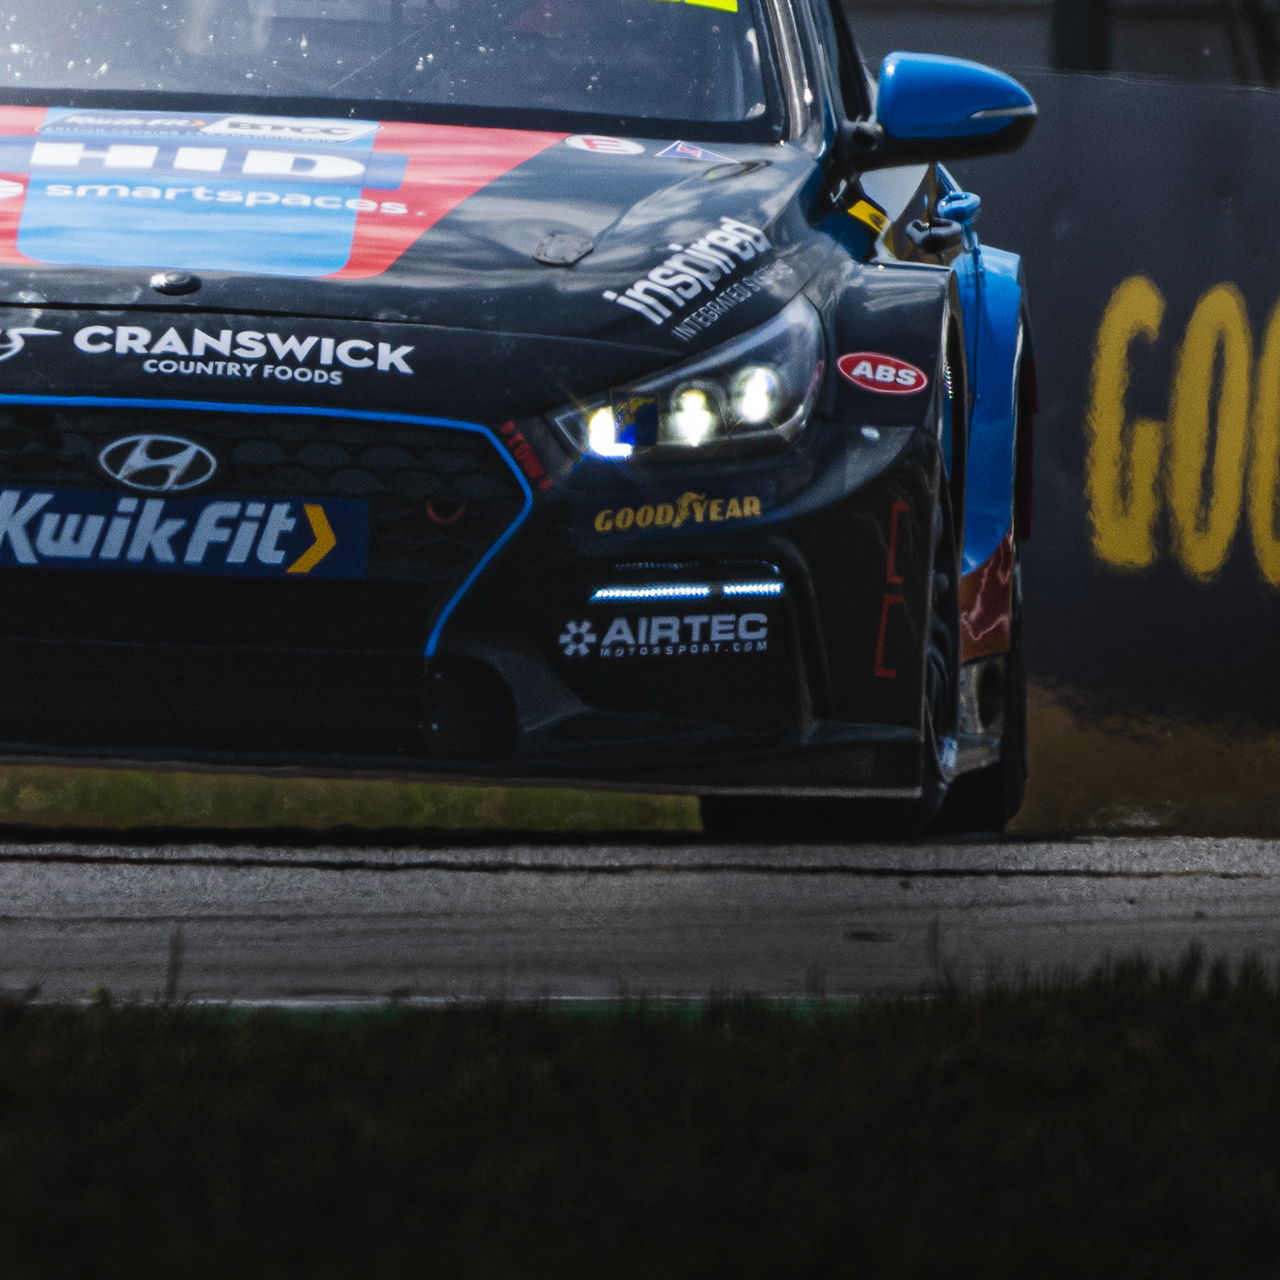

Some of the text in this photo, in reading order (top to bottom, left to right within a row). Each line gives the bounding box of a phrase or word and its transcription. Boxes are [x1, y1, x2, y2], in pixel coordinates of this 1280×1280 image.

[30, 141, 366, 179] HID
[45, 184, 408, 215] smartspaces
[602, 216, 772, 325] inspired
[670, 282, 753, 342] INTEGRATED
[73, 325, 415, 375] CRANSWICK
[142, 358, 343, 386] COUNTRY FOODS
[851, 360, 918, 387] ABS
[594, 495, 762, 533] GOODYEAR
[600, 613, 768, 647] AIRTEC
